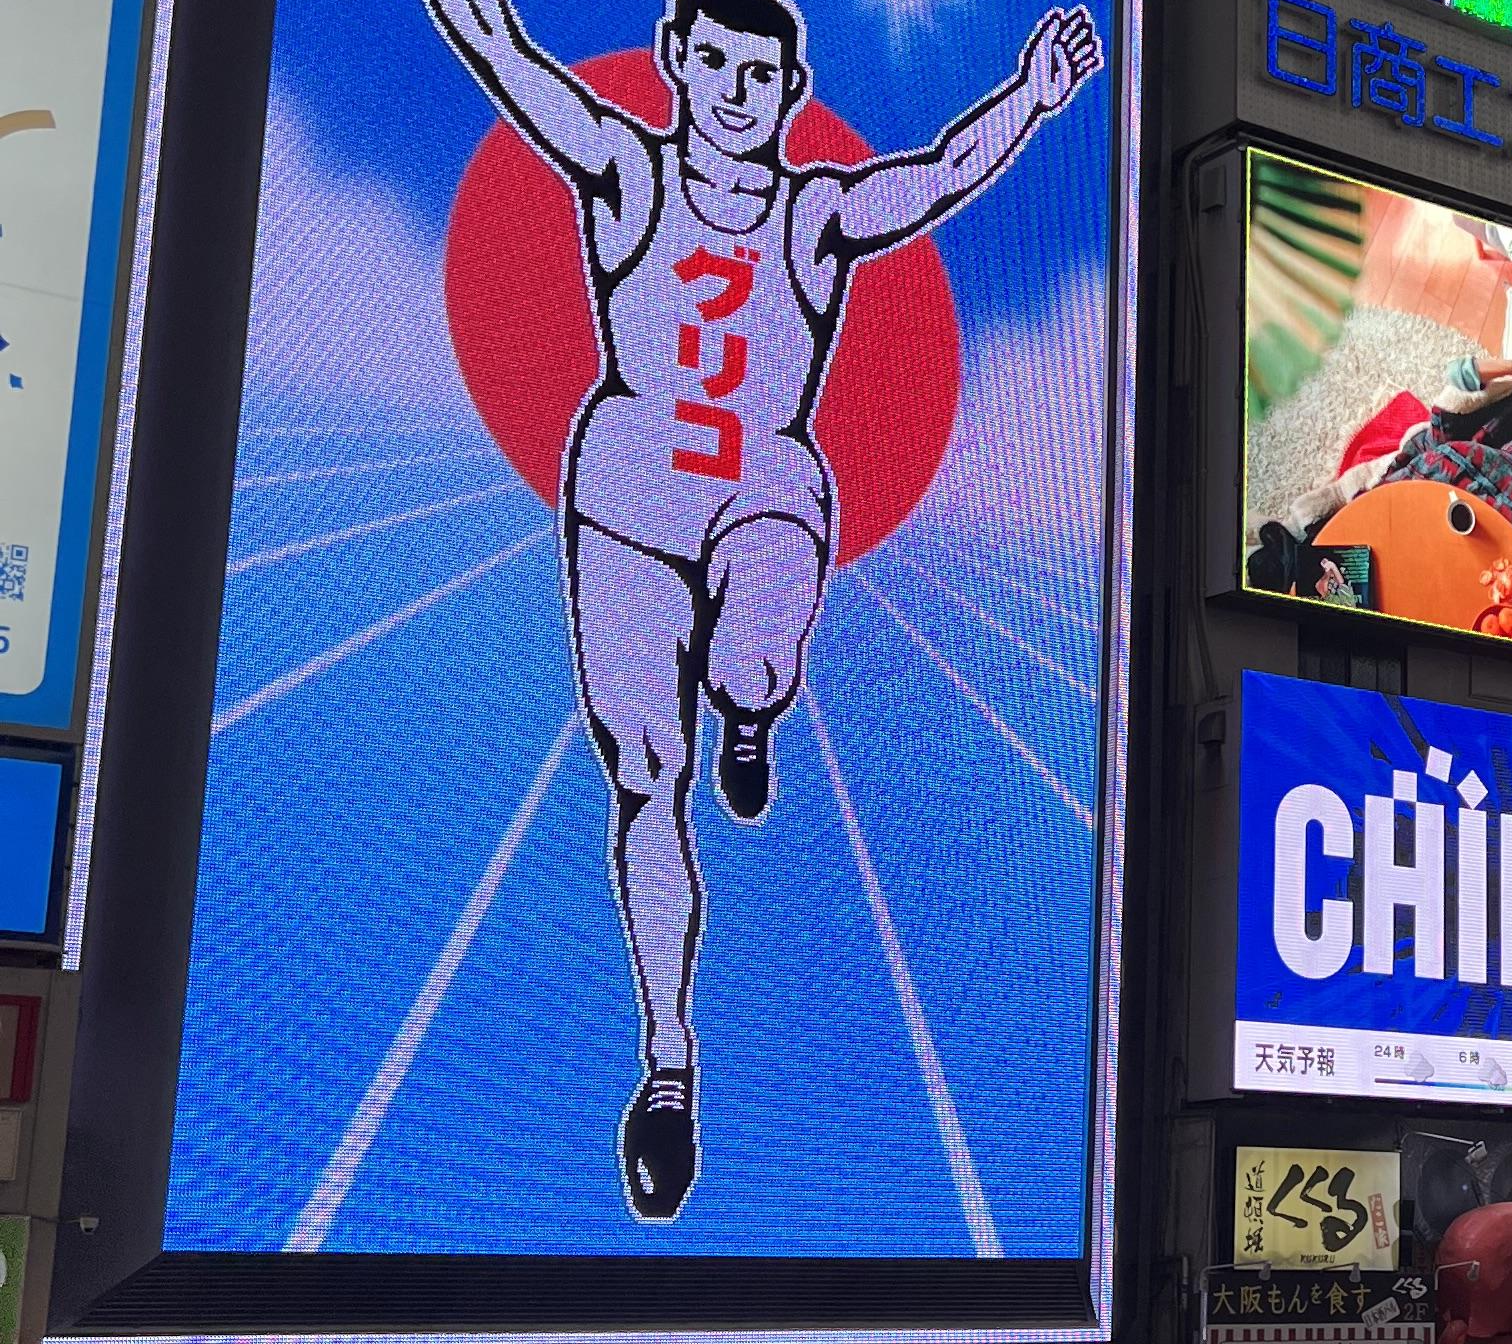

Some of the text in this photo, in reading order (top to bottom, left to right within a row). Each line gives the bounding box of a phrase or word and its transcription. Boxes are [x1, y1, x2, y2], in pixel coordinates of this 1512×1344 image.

[672, 243, 761, 482] グリコ
[1255, 1043, 1335, 1076] 天気予報
[1266, 1163, 1369, 1252] くくる
[1212, 1282, 1372, 1315] 大阪もんを食す
